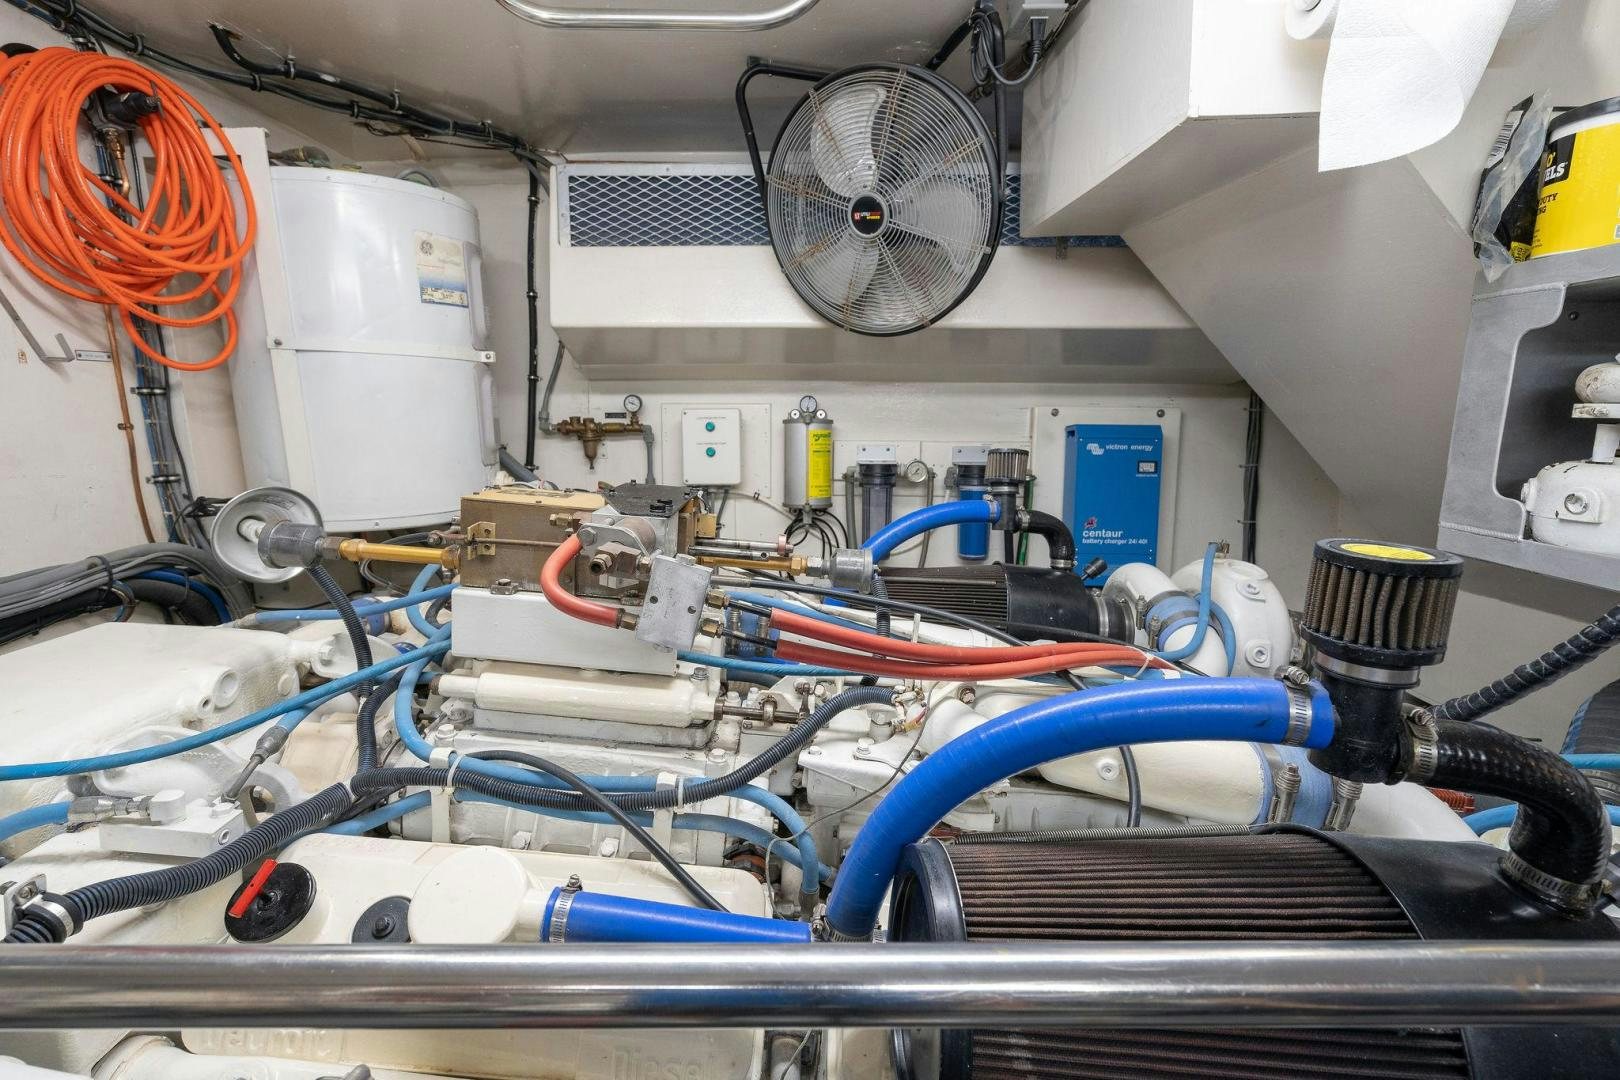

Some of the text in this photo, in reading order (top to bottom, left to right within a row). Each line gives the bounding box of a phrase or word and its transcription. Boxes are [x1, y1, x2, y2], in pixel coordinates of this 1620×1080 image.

[1544, 163, 1566, 181] ELS
[1130, 443, 1153, 452] energy
[1082, 529, 1123, 537] centaur
